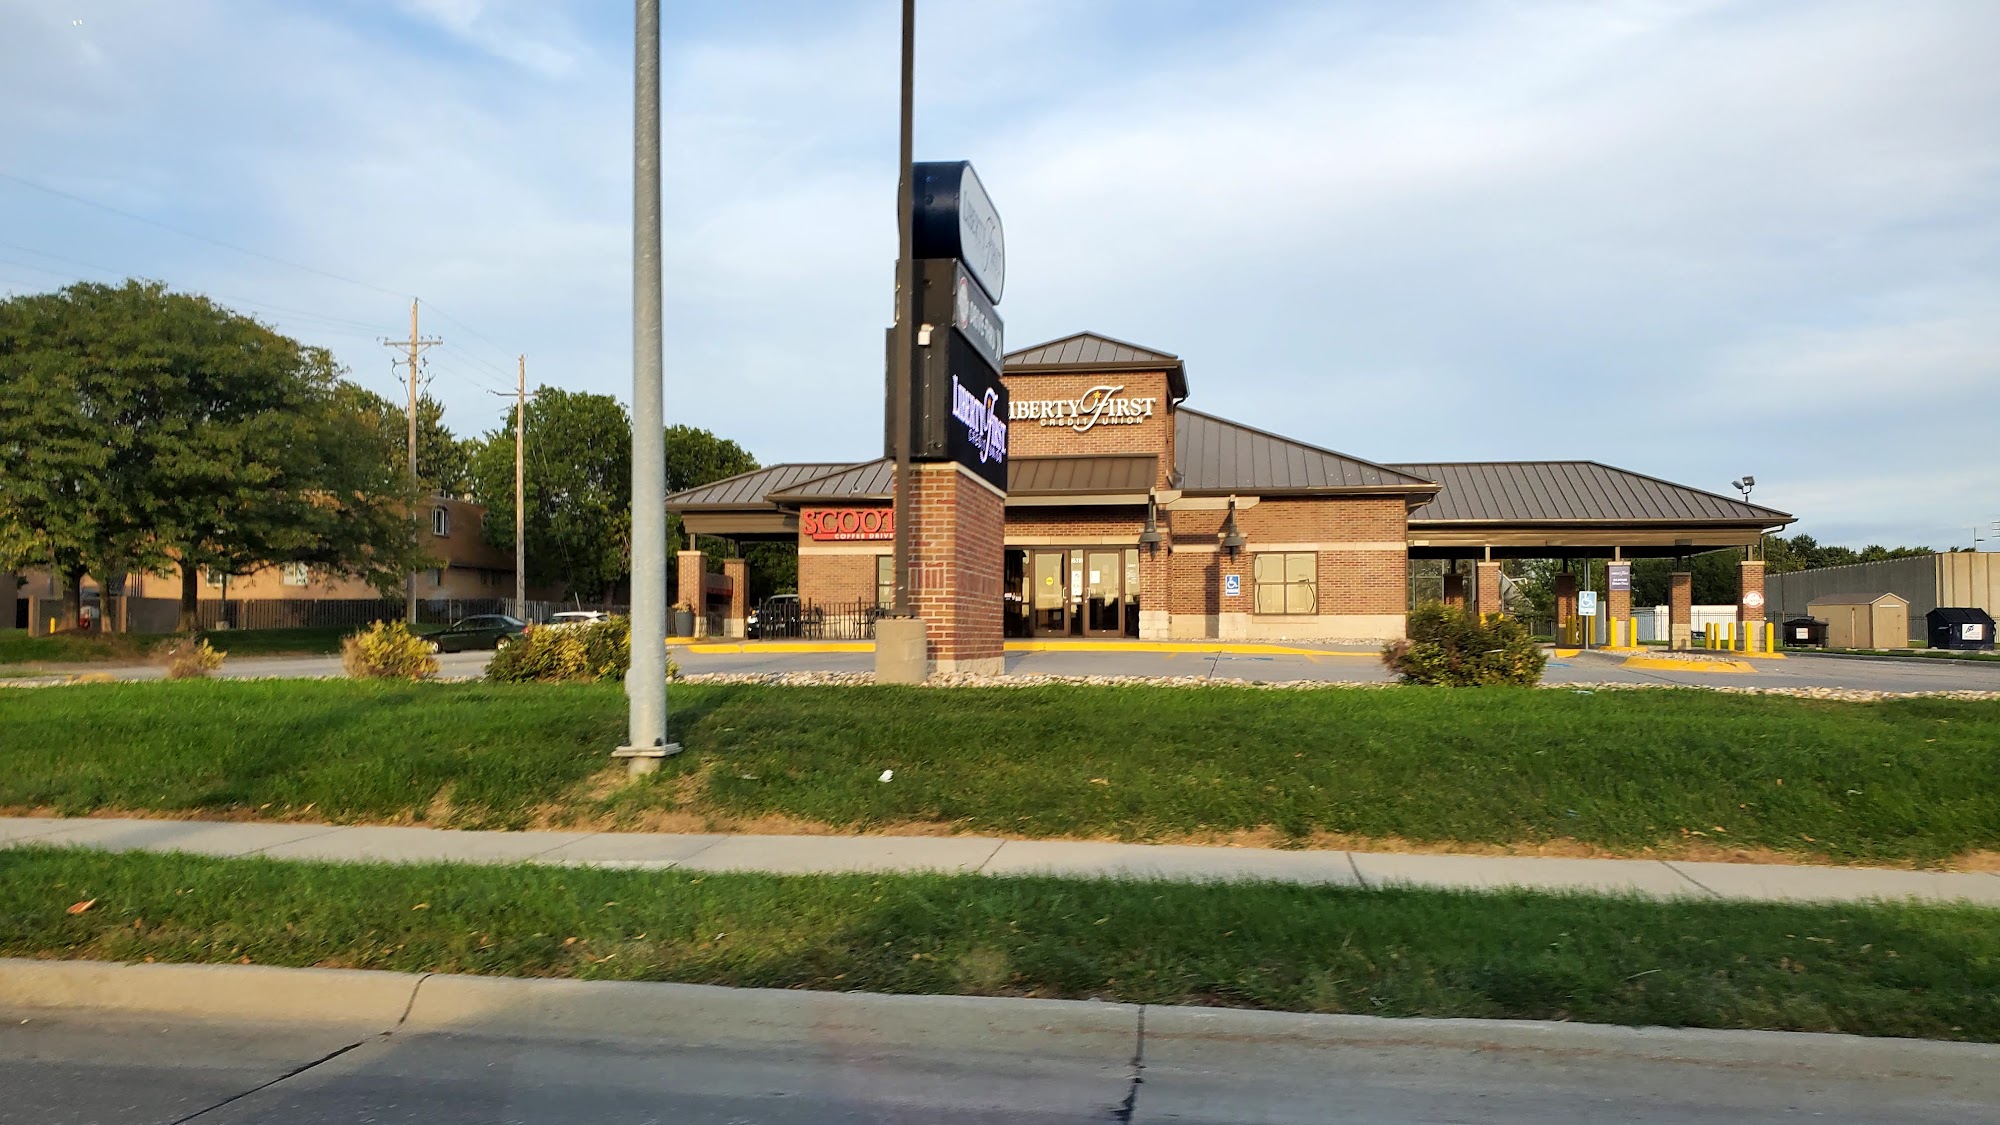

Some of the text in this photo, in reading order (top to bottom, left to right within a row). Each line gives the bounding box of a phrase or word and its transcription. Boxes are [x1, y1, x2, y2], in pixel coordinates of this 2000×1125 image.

[952, 374, 988, 436] LIBERTY
[1008, 385, 1157, 432] IBERTY FIRST
[1040, 416, 1143, 427] CREDIT UNION
